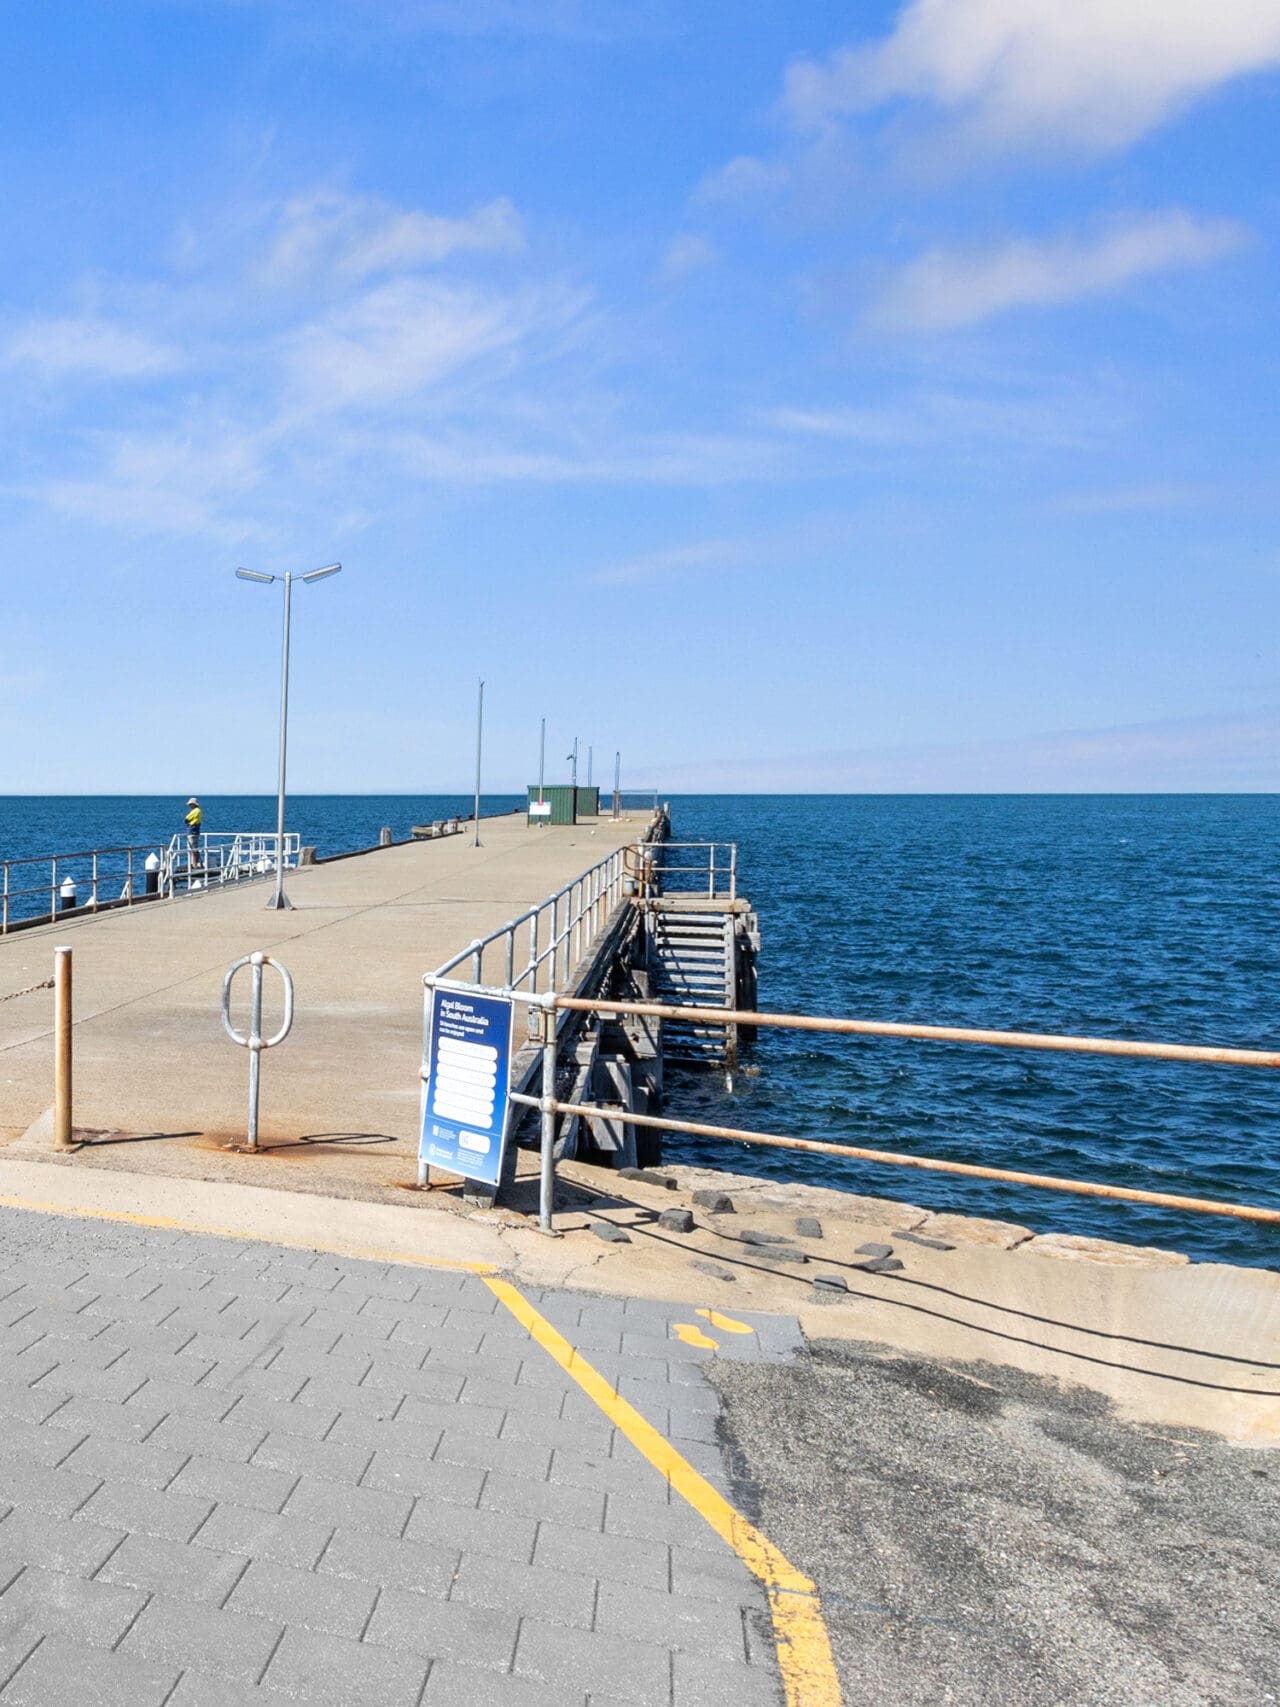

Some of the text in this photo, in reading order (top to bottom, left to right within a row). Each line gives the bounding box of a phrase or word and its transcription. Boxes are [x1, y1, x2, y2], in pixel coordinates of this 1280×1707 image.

[455, 1001, 473, 1013] Bloom
[446, 1010, 461, 1020] South
[462, 1013, 489, 1026] Australia
